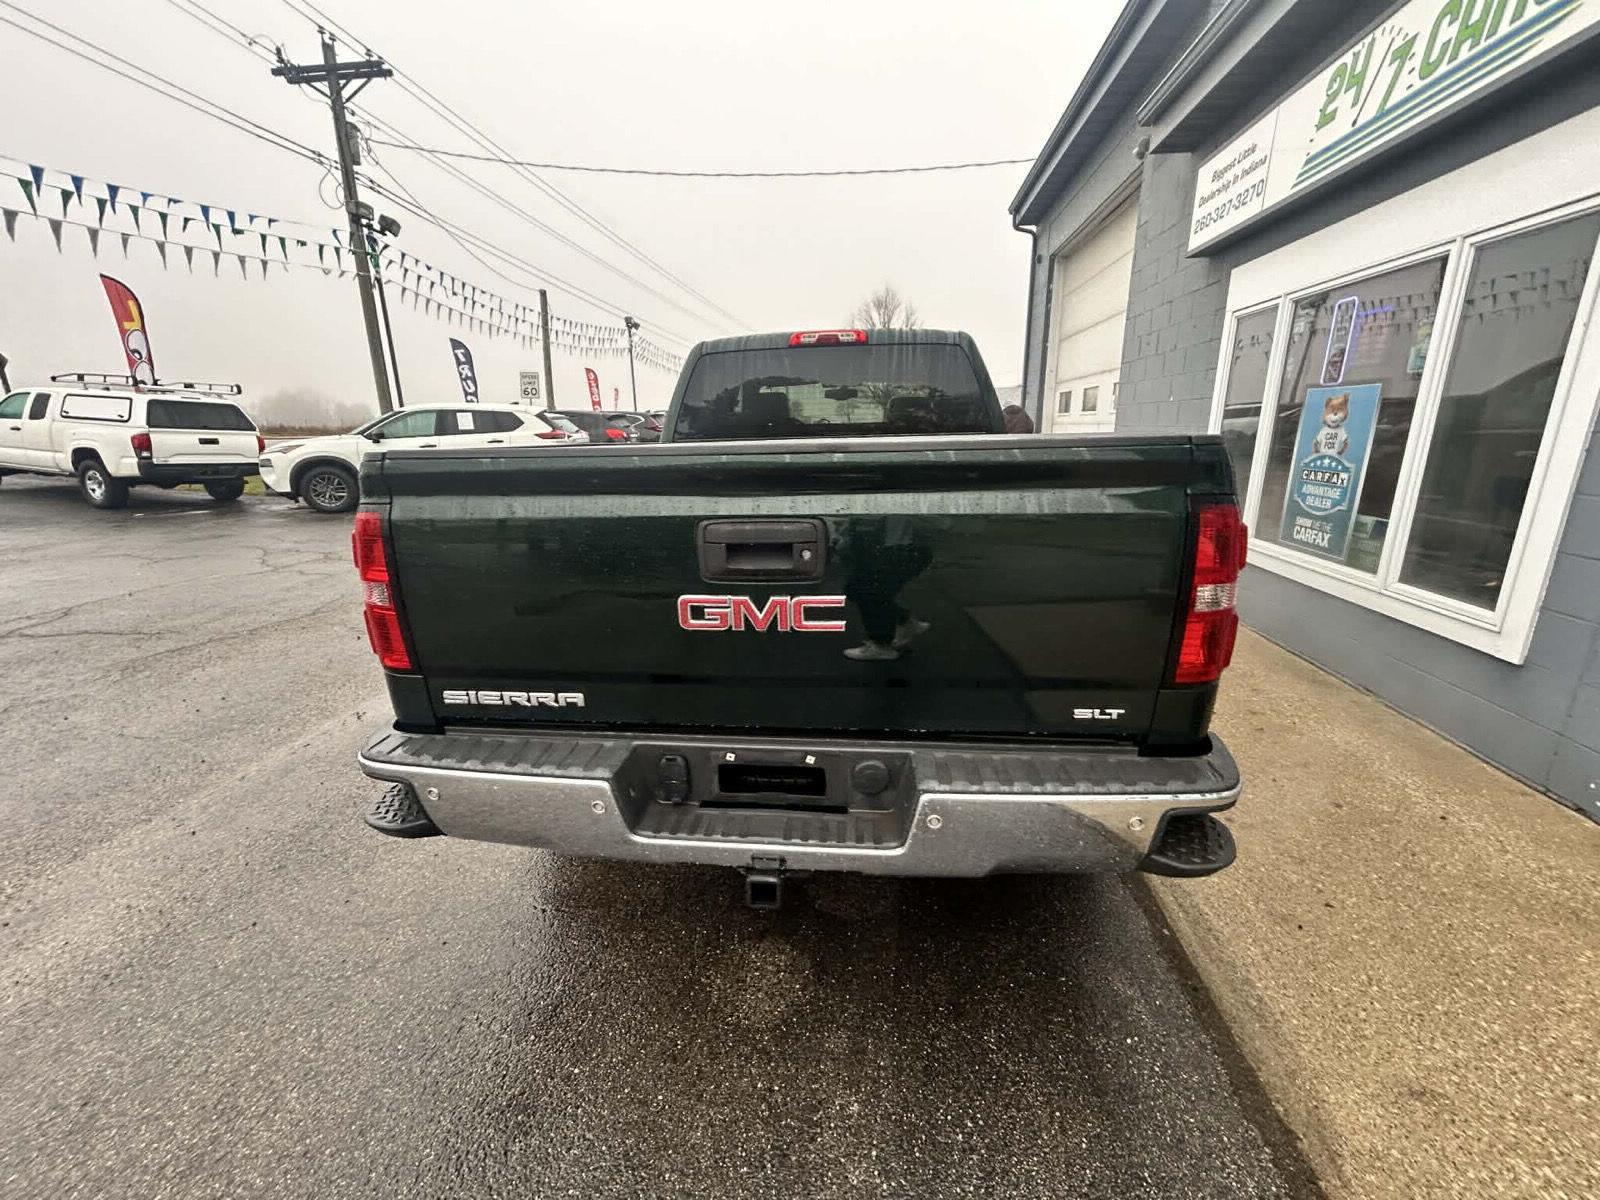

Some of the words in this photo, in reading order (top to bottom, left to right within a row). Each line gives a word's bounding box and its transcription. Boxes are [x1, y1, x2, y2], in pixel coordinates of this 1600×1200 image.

[1211, 158, 1237, 183] Biggest
[1237, 143, 1257, 164] Little
[1199, 179, 1232, 208] Dealership
[1240, 154, 1268, 180] Indiana
[1194, 178, 1265, 235] 260-327-3270
[523, 387, 538, 396] 60
[1324, 432, 1338, 441] CAR
[1323, 440, 1335, 450] FOX
[1302, 470, 1347, 486] CARFAX
[1301, 483, 1341, 499] ADVANTAGE
[1305, 495, 1332, 509] DEALER
[1295, 516, 1313, 528] SHOW
[1293, 526, 1331, 547] CARFAX
[677, 594, 847, 632] GMC
[442, 690, 585, 707] SIERRA
[1072, 708, 1126, 720] SLT
